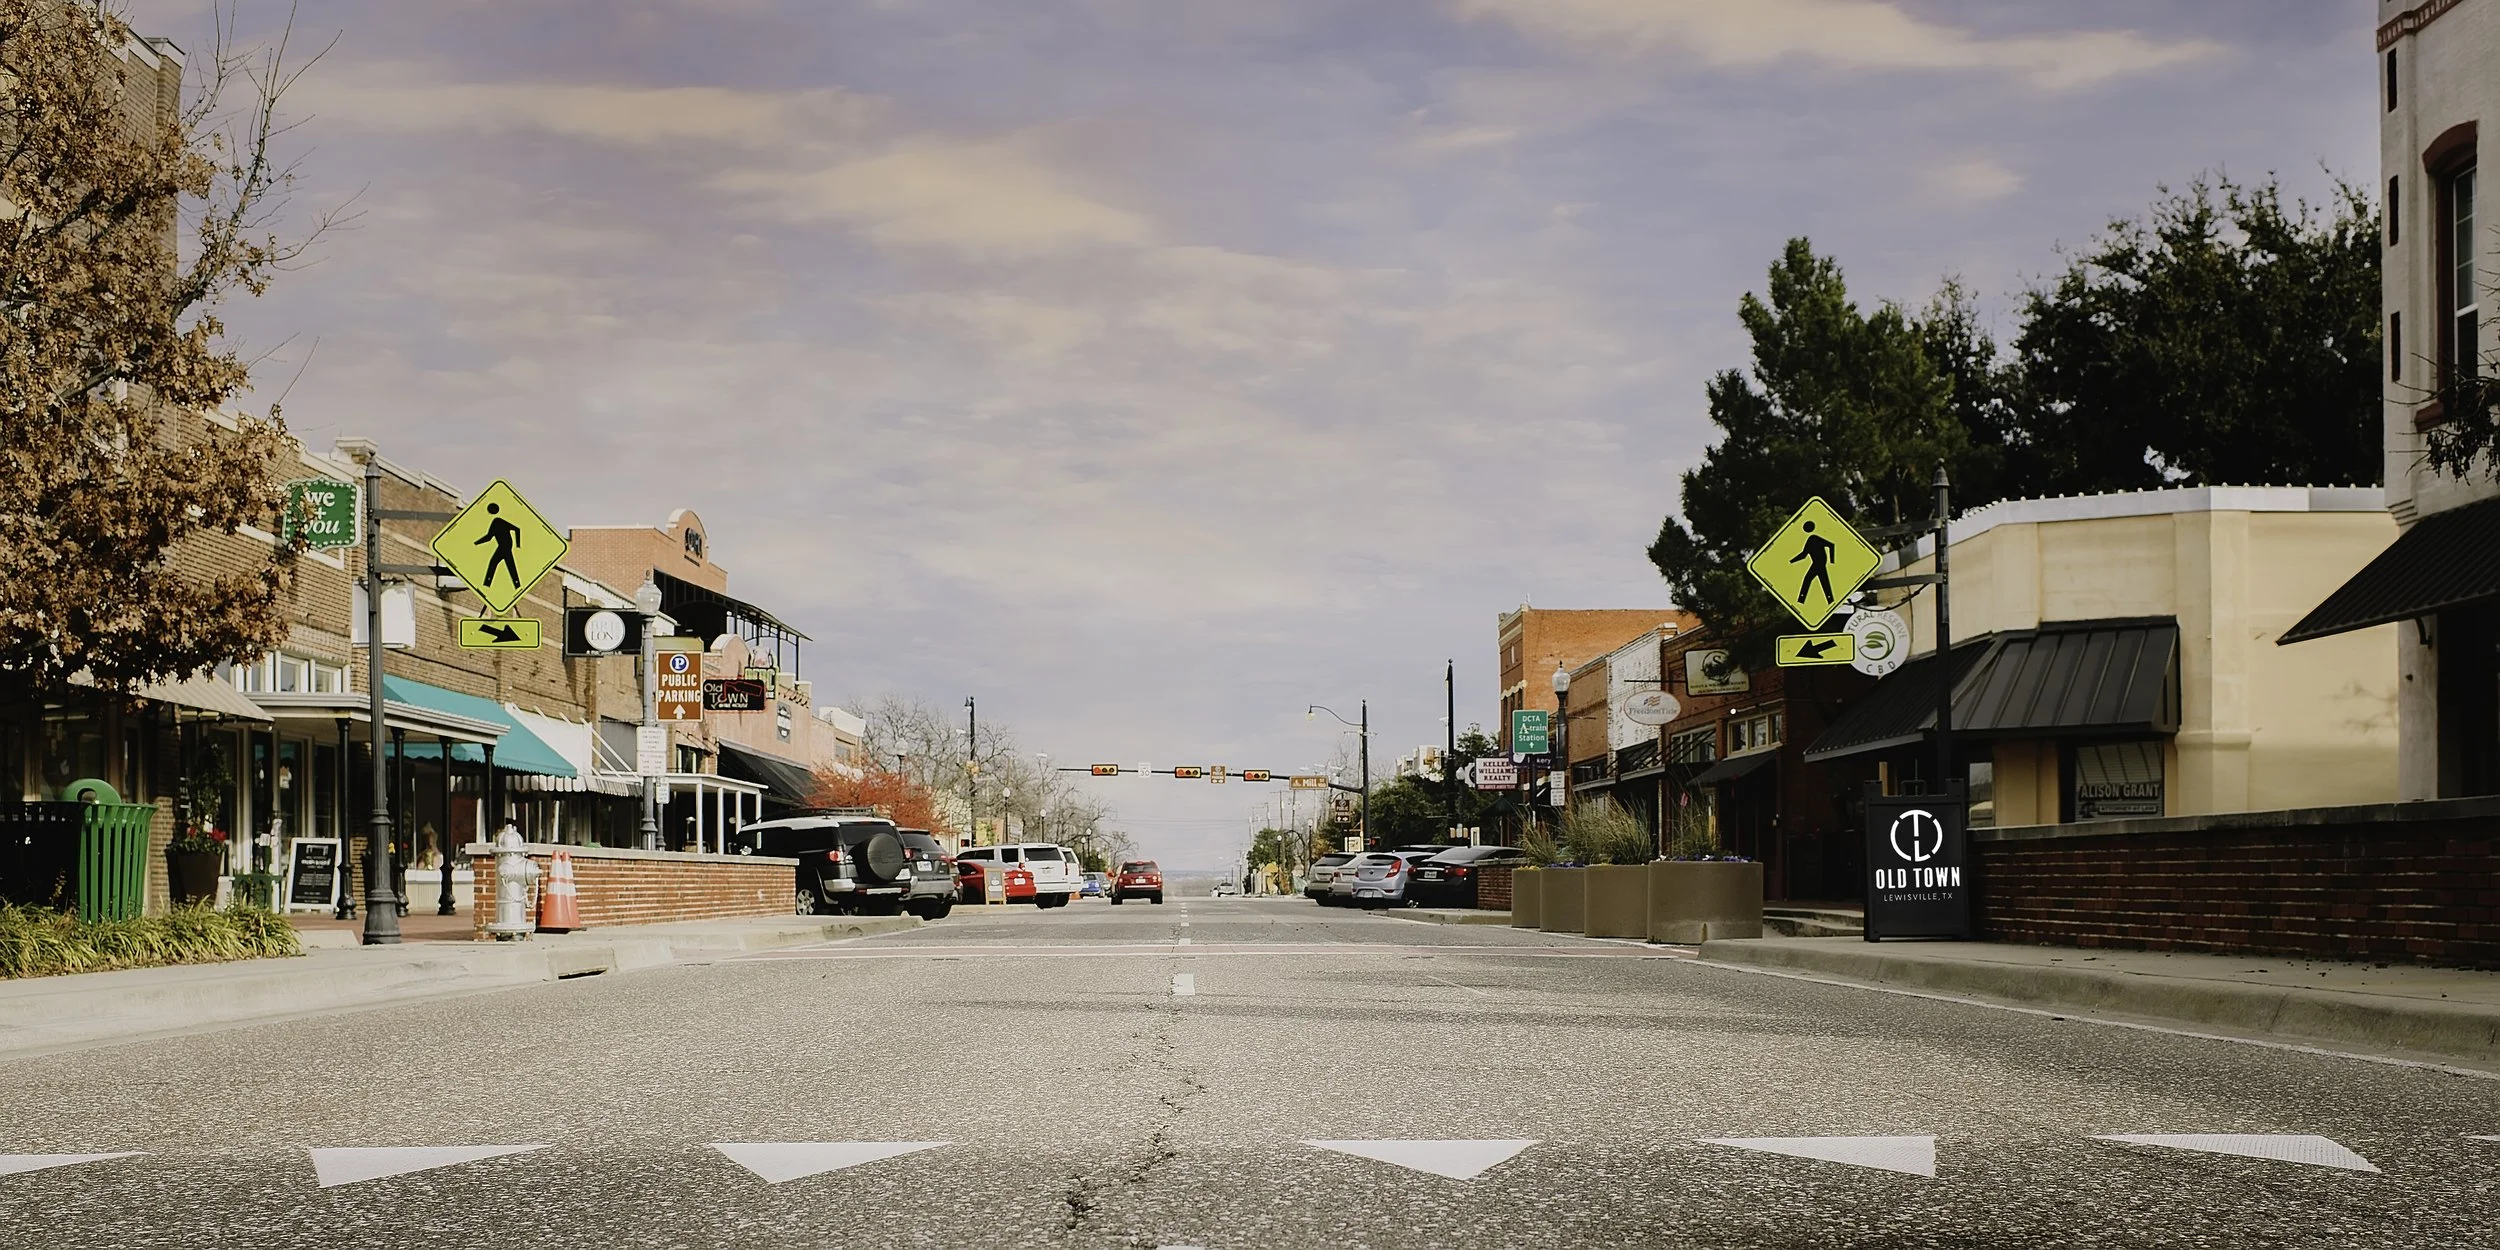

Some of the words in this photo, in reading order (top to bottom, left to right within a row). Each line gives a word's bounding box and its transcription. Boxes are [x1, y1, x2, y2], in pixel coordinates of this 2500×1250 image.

[303, 491, 336, 507] we
[1877, 612, 1907, 638] RESERVE
[674, 657, 685, 670] P
[1865, 660, 1896, 674] CBD
[661, 673, 698, 687] PUBLIC
[703, 683, 723, 693] Old
[658, 689, 701, 703] PARKING
[709, 692, 749, 703] TOWN
[1519, 723, 1548, 734] A-train
[1518, 734, 1545, 742] Station
[1302, 778, 1318, 787] Mill
[2080, 784, 2120, 798] ALISON
[2122, 783, 2160, 797] GRANT
[1875, 868, 1907, 889] OLD
[1912, 866, 1960, 888] TOWN
[1883, 892, 1941, 902] LEWISVILLE,
